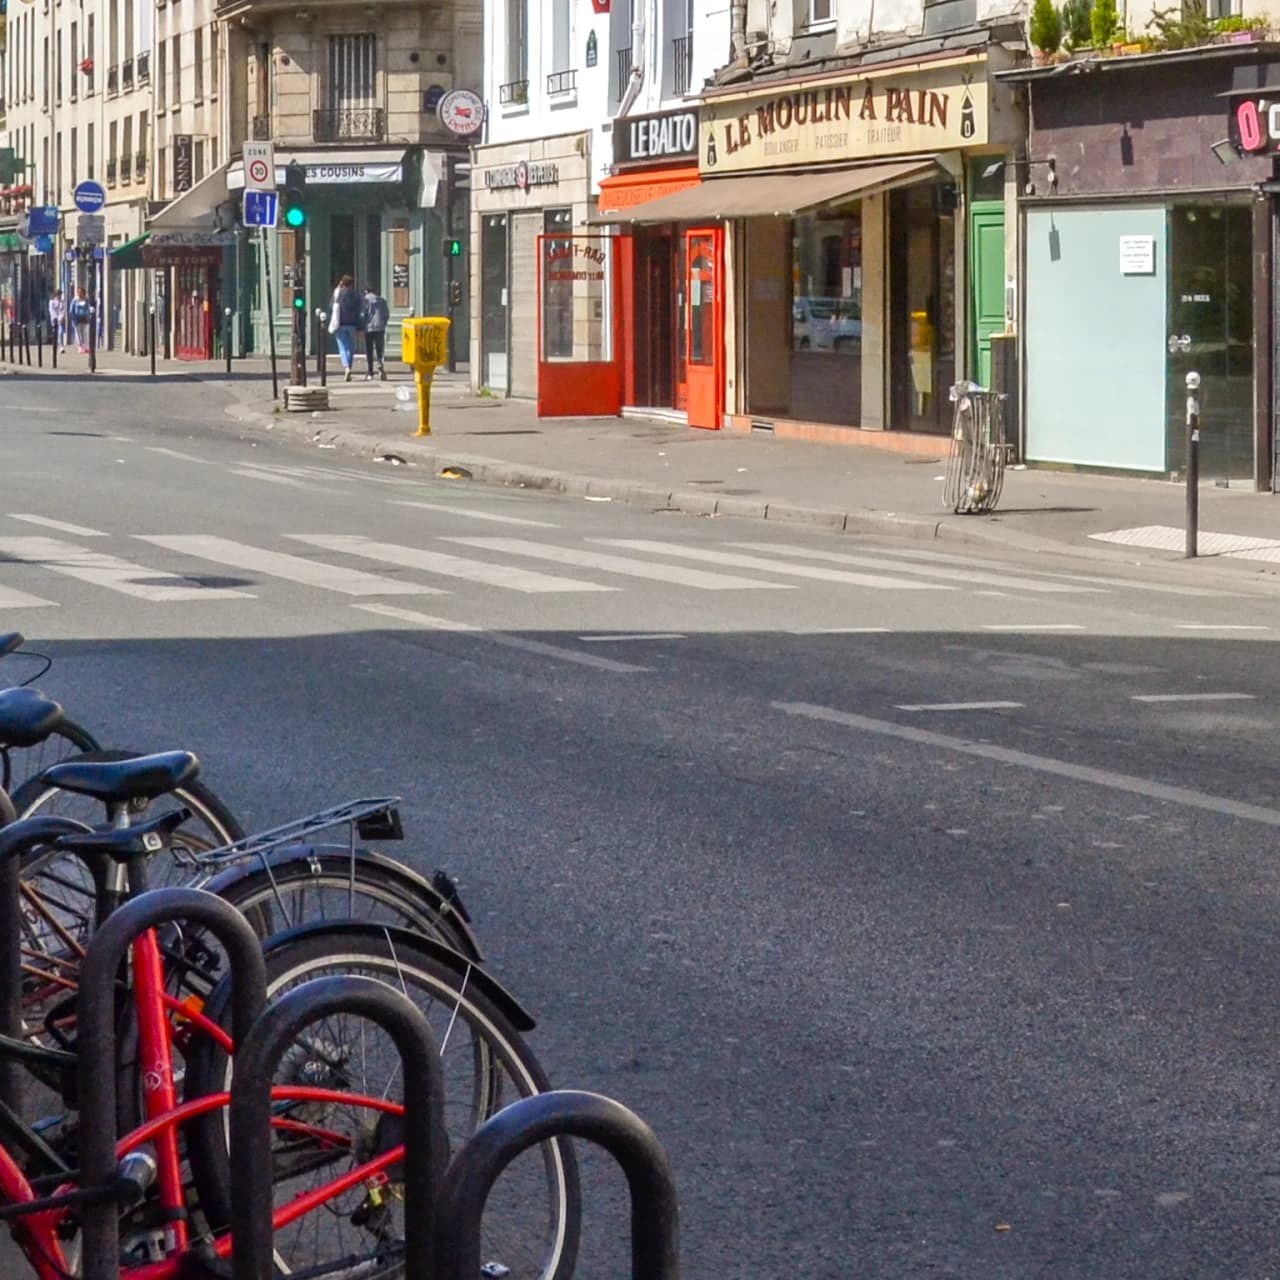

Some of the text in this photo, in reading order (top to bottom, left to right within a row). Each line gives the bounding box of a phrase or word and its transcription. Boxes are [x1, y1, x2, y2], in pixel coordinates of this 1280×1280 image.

[724, 114, 751, 156] LE
[755, 85, 852, 139] MOULIN
[884, 86, 950, 131] PAIN
[631, 113, 696, 158] LE BALTO
[177, 136, 190, 193] PIZZA
[248, 148, 267, 156] ZONE
[254, 167, 264, 176] 30
[320, 166, 365, 178] COUSINS
